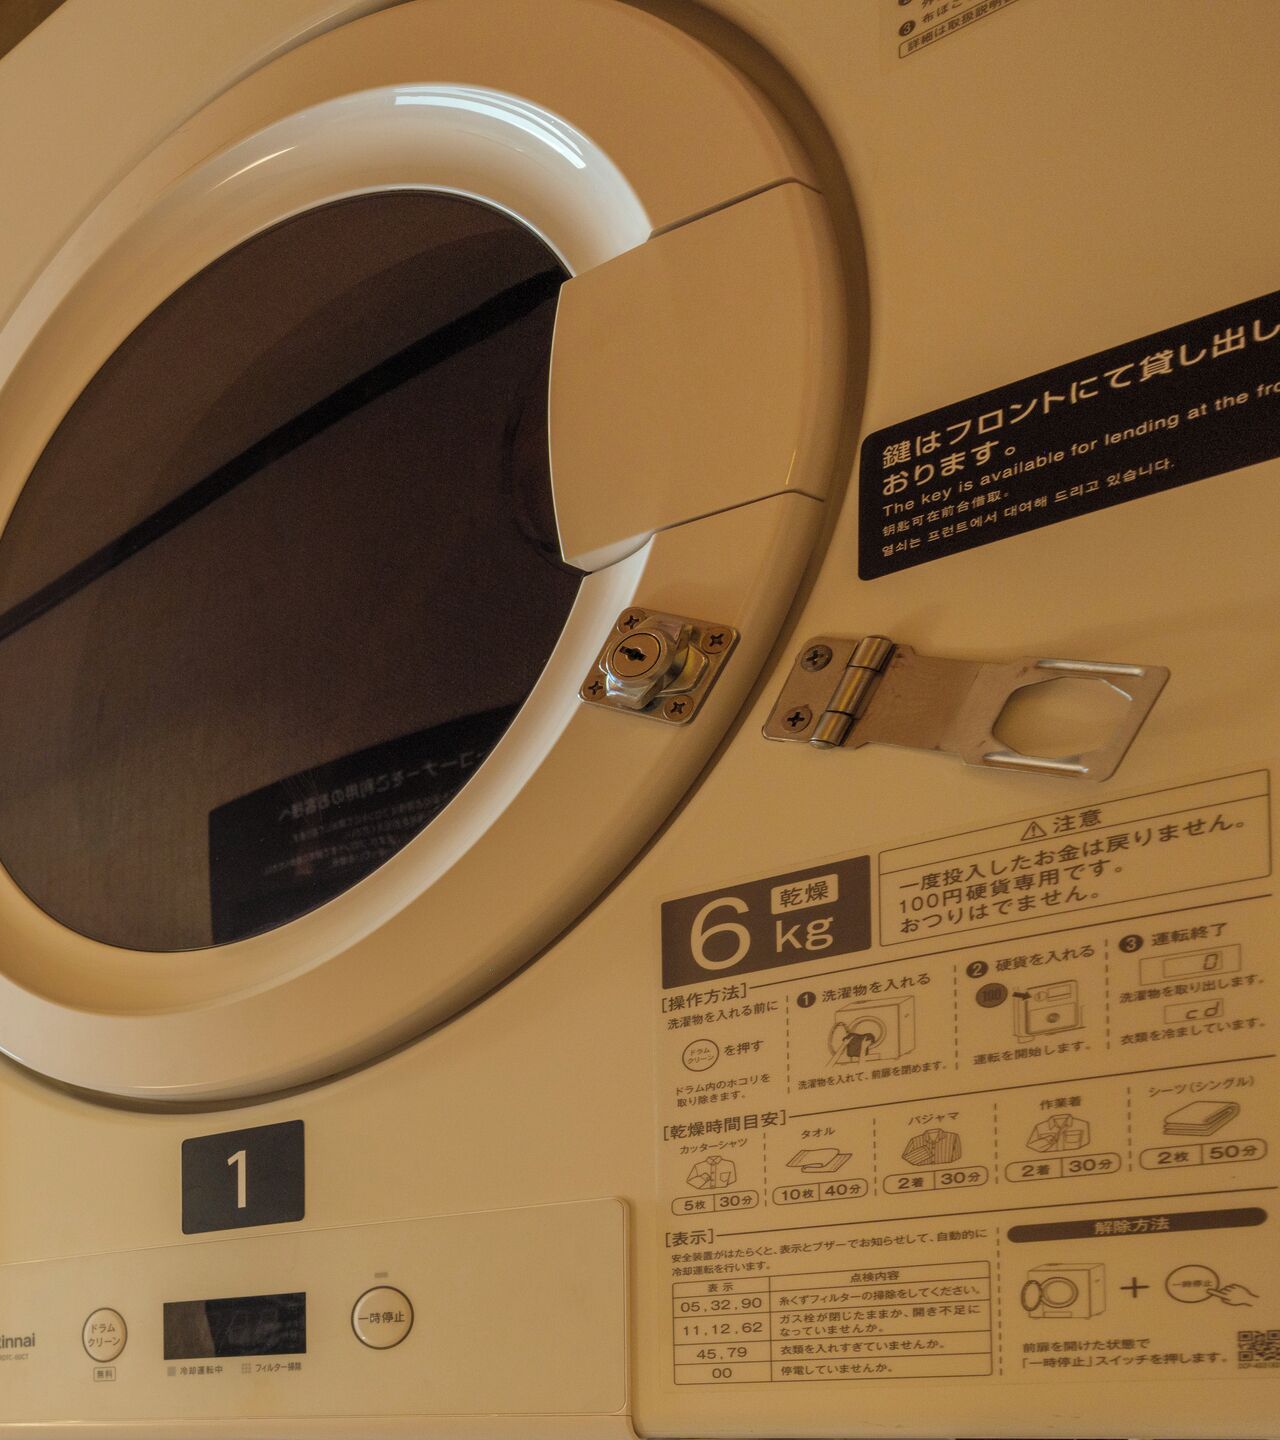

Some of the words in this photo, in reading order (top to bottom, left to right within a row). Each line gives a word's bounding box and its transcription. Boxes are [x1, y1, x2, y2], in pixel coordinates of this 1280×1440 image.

[882, 319, 1280, 469] 鍵はフロントにて貸し出し
[883, 496, 914, 518] The
[922, 484, 952, 508] key
[958, 476, 973, 494] is
[980, 447, 1064, 487] available
[1071, 436, 1097, 458] for
[1105, 411, 1179, 449] lending
[1187, 402, 1207, 421] at
[1214, 388, 1248, 412] the
[882, 438, 1016, 497] おります。
[882, 533, 920, 558] 열쇠는
[927, 509, 997, 543] 프런트에서
[1004, 493, 1048, 519] 대여해
[1054, 478, 1099, 504] 드리고
[1106, 454, 1175, 488] 있습니다.
[1053, 807, 1102, 834] 注意
[899, 807, 1247, 895] 一度投入したお金は戻りません。
[780, 879, 829, 909] 乾燥
[899, 854, 1123, 915] 100円硬貨専用です。
[900, 880, 1100, 935] おつりはでません。
[690, 891, 750, 975] 6
[775, 909, 834, 958] kg
[1151, 919, 1228, 948] 運転終了
[995, 942, 1095, 973] 硬貨を入れる
[661, 982, 747, 1012] [操作方法]
[822, 971, 931, 1003] 洗濯物を入れる
[667, 999, 778, 1030] 洗濯物を入れる前に
[724, 1039, 763, 1057] を押す
[973, 1038, 1091, 1066] 運転を開始します。
[1040, 1094, 1082, 1110] 作業着
[663, 1109, 786, 1141] [乾燥時間目安]
[908, 1110, 959, 1126] パジャマ
[801, 1126, 835, 1139] タオル
[680, 1137, 747, 1154] カッターシャツ
[1157, 1149, 1189, 1165] 2枚
[1208, 1142, 1258, 1160] 50分
[1021, 1163, 1050, 1177] 2着
[1068, 1156, 1112, 1173] 30分
[227, 1150, 246, 1208] 1
[897, 1175, 923, 1189] 2着
[940, 1170, 980, 1185] 30分
[684, 1198, 706, 1211] 5枚
[719, 1194, 752, 1207] 30分
[782, 1187, 813, 1201] 10枚
[825, 1182, 860, 1197] 40分
[1094, 1216, 1169, 1235] 解除方法
[665, 1229, 713, 1247] [表示]
[850, 1270, 899, 1284] 点検内容
[91, 1323, 116, 1334] ドラム
[358, 1311, 406, 1324] 一時停止
[88, 1337, 121, 1348] クリーン
[781, 1338, 944, 1355] 衣類を入れすぎていませんか。
[96, 1369, 113, 1379] 無料
[179, 1364, 224, 1376] 冷却運転中
[712, 1367, 732, 1378] 00
[781, 1362, 893, 1376] 停電していませんか。
